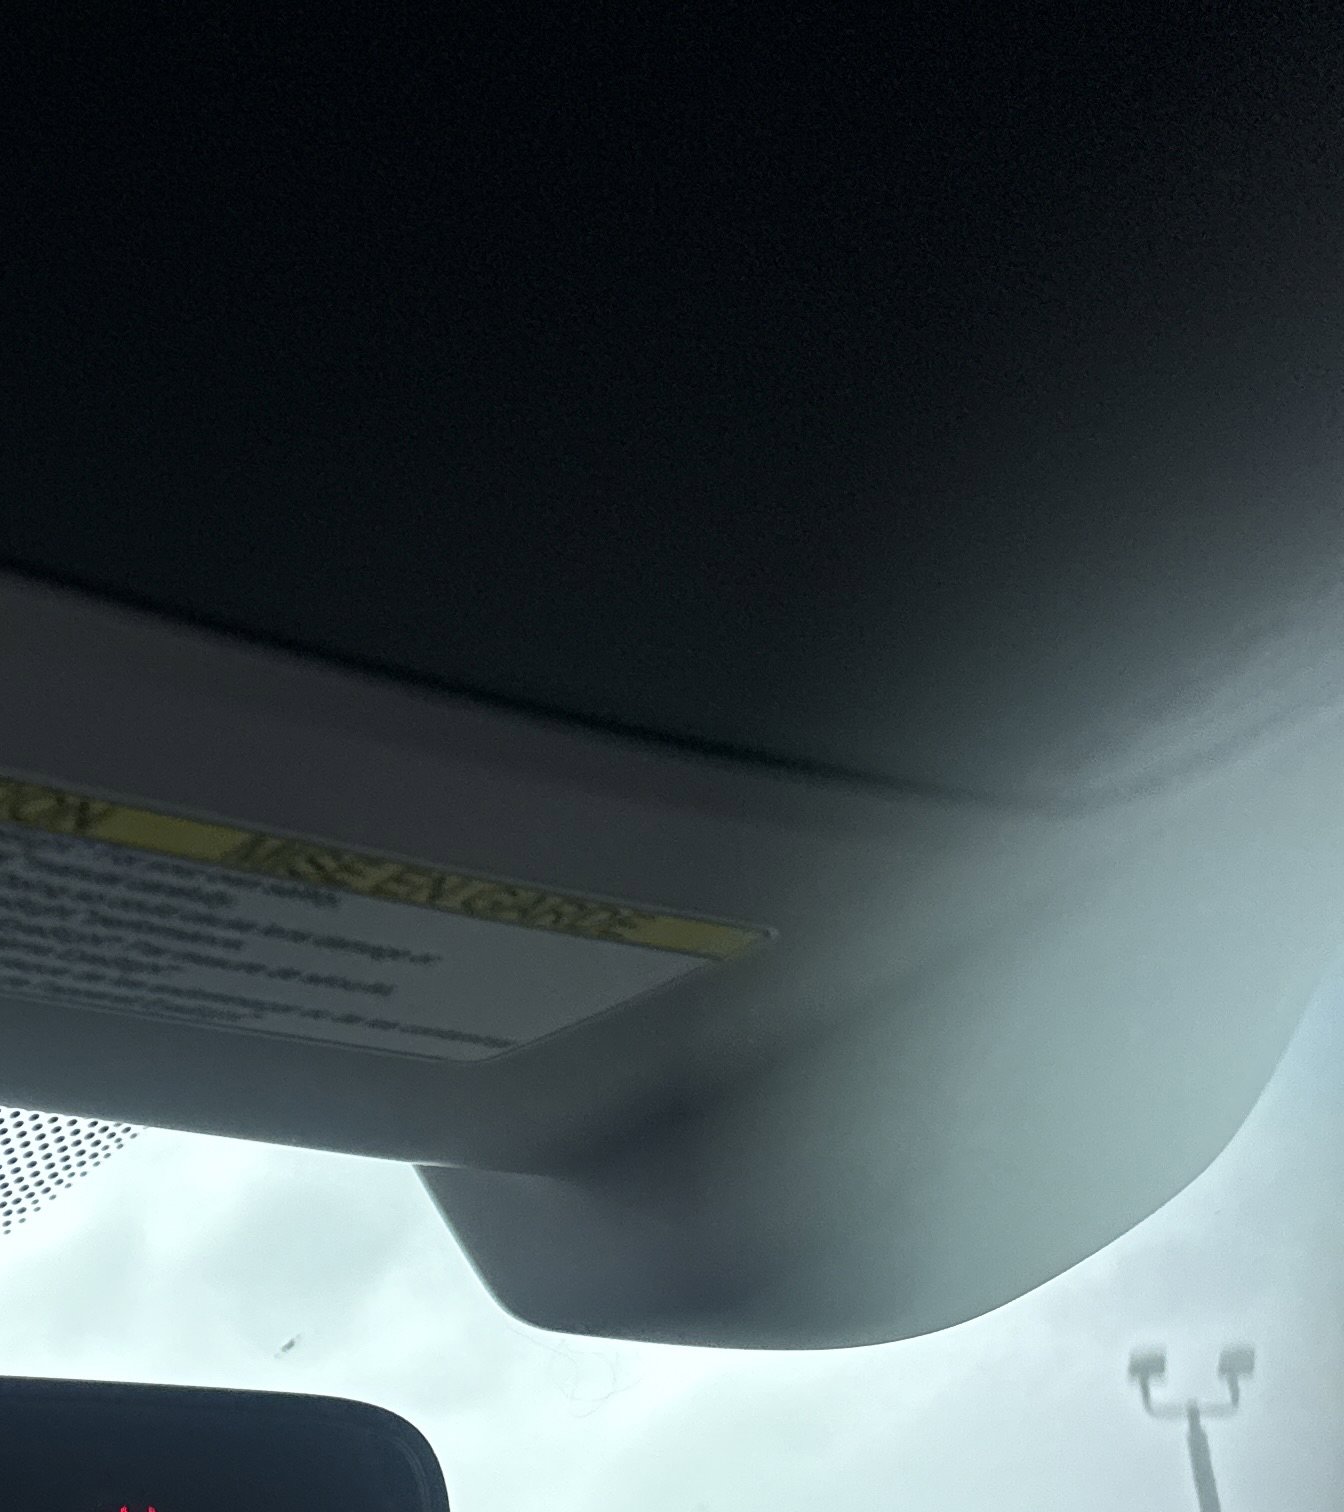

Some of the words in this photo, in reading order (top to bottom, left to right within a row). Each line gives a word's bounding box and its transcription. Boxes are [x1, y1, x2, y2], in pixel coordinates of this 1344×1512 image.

[223, 834, 384, 887] MISE
[374, 867, 478, 906] EN
[458, 883, 648, 939] GARDE
